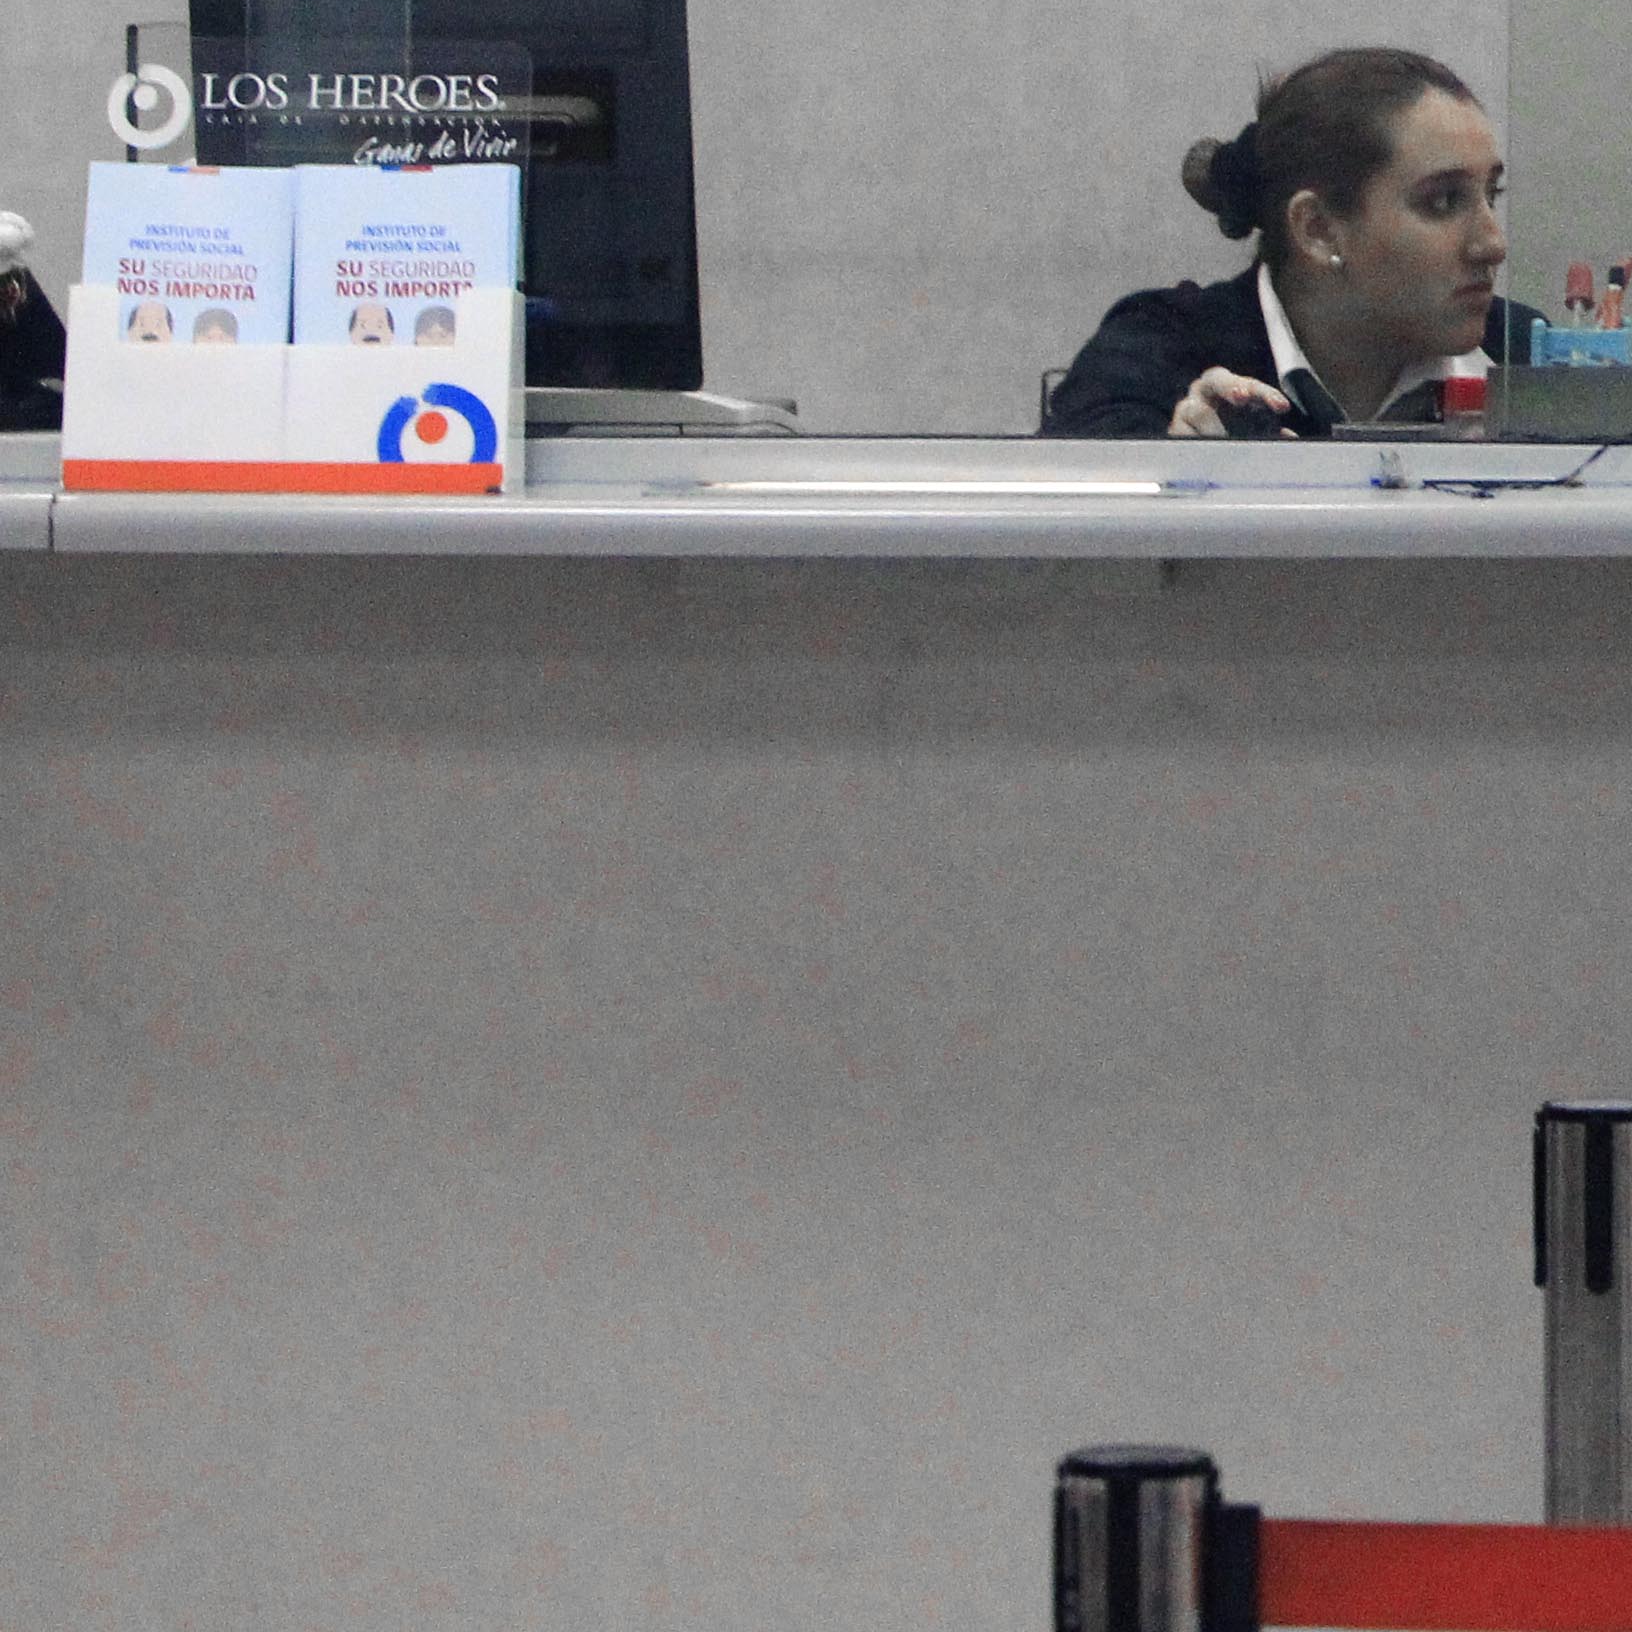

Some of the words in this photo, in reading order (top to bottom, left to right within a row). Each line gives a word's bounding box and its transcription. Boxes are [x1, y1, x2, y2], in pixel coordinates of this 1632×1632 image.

[201, 72, 289, 110] LOS
[428, 130, 456, 159] de
[145, 224, 211, 240] INSTITUTO
[215, 227, 230, 241] DE
[362, 224, 427, 238] INSTITUTO
[430, 225, 447, 237] DE
[200, 243, 245, 256] SOCIAL
[416, 241, 461, 253] SOCIAL
[119, 257, 145, 275] SU
[152, 260, 257, 282] SEGURIDAD
[336, 259, 363, 277] SU
[369, 260, 475, 278] SEGURIDAD
[117, 277, 159, 296] NOS
[165, 280, 256, 300] IMPORTA
[336, 279, 378, 297] NOS
